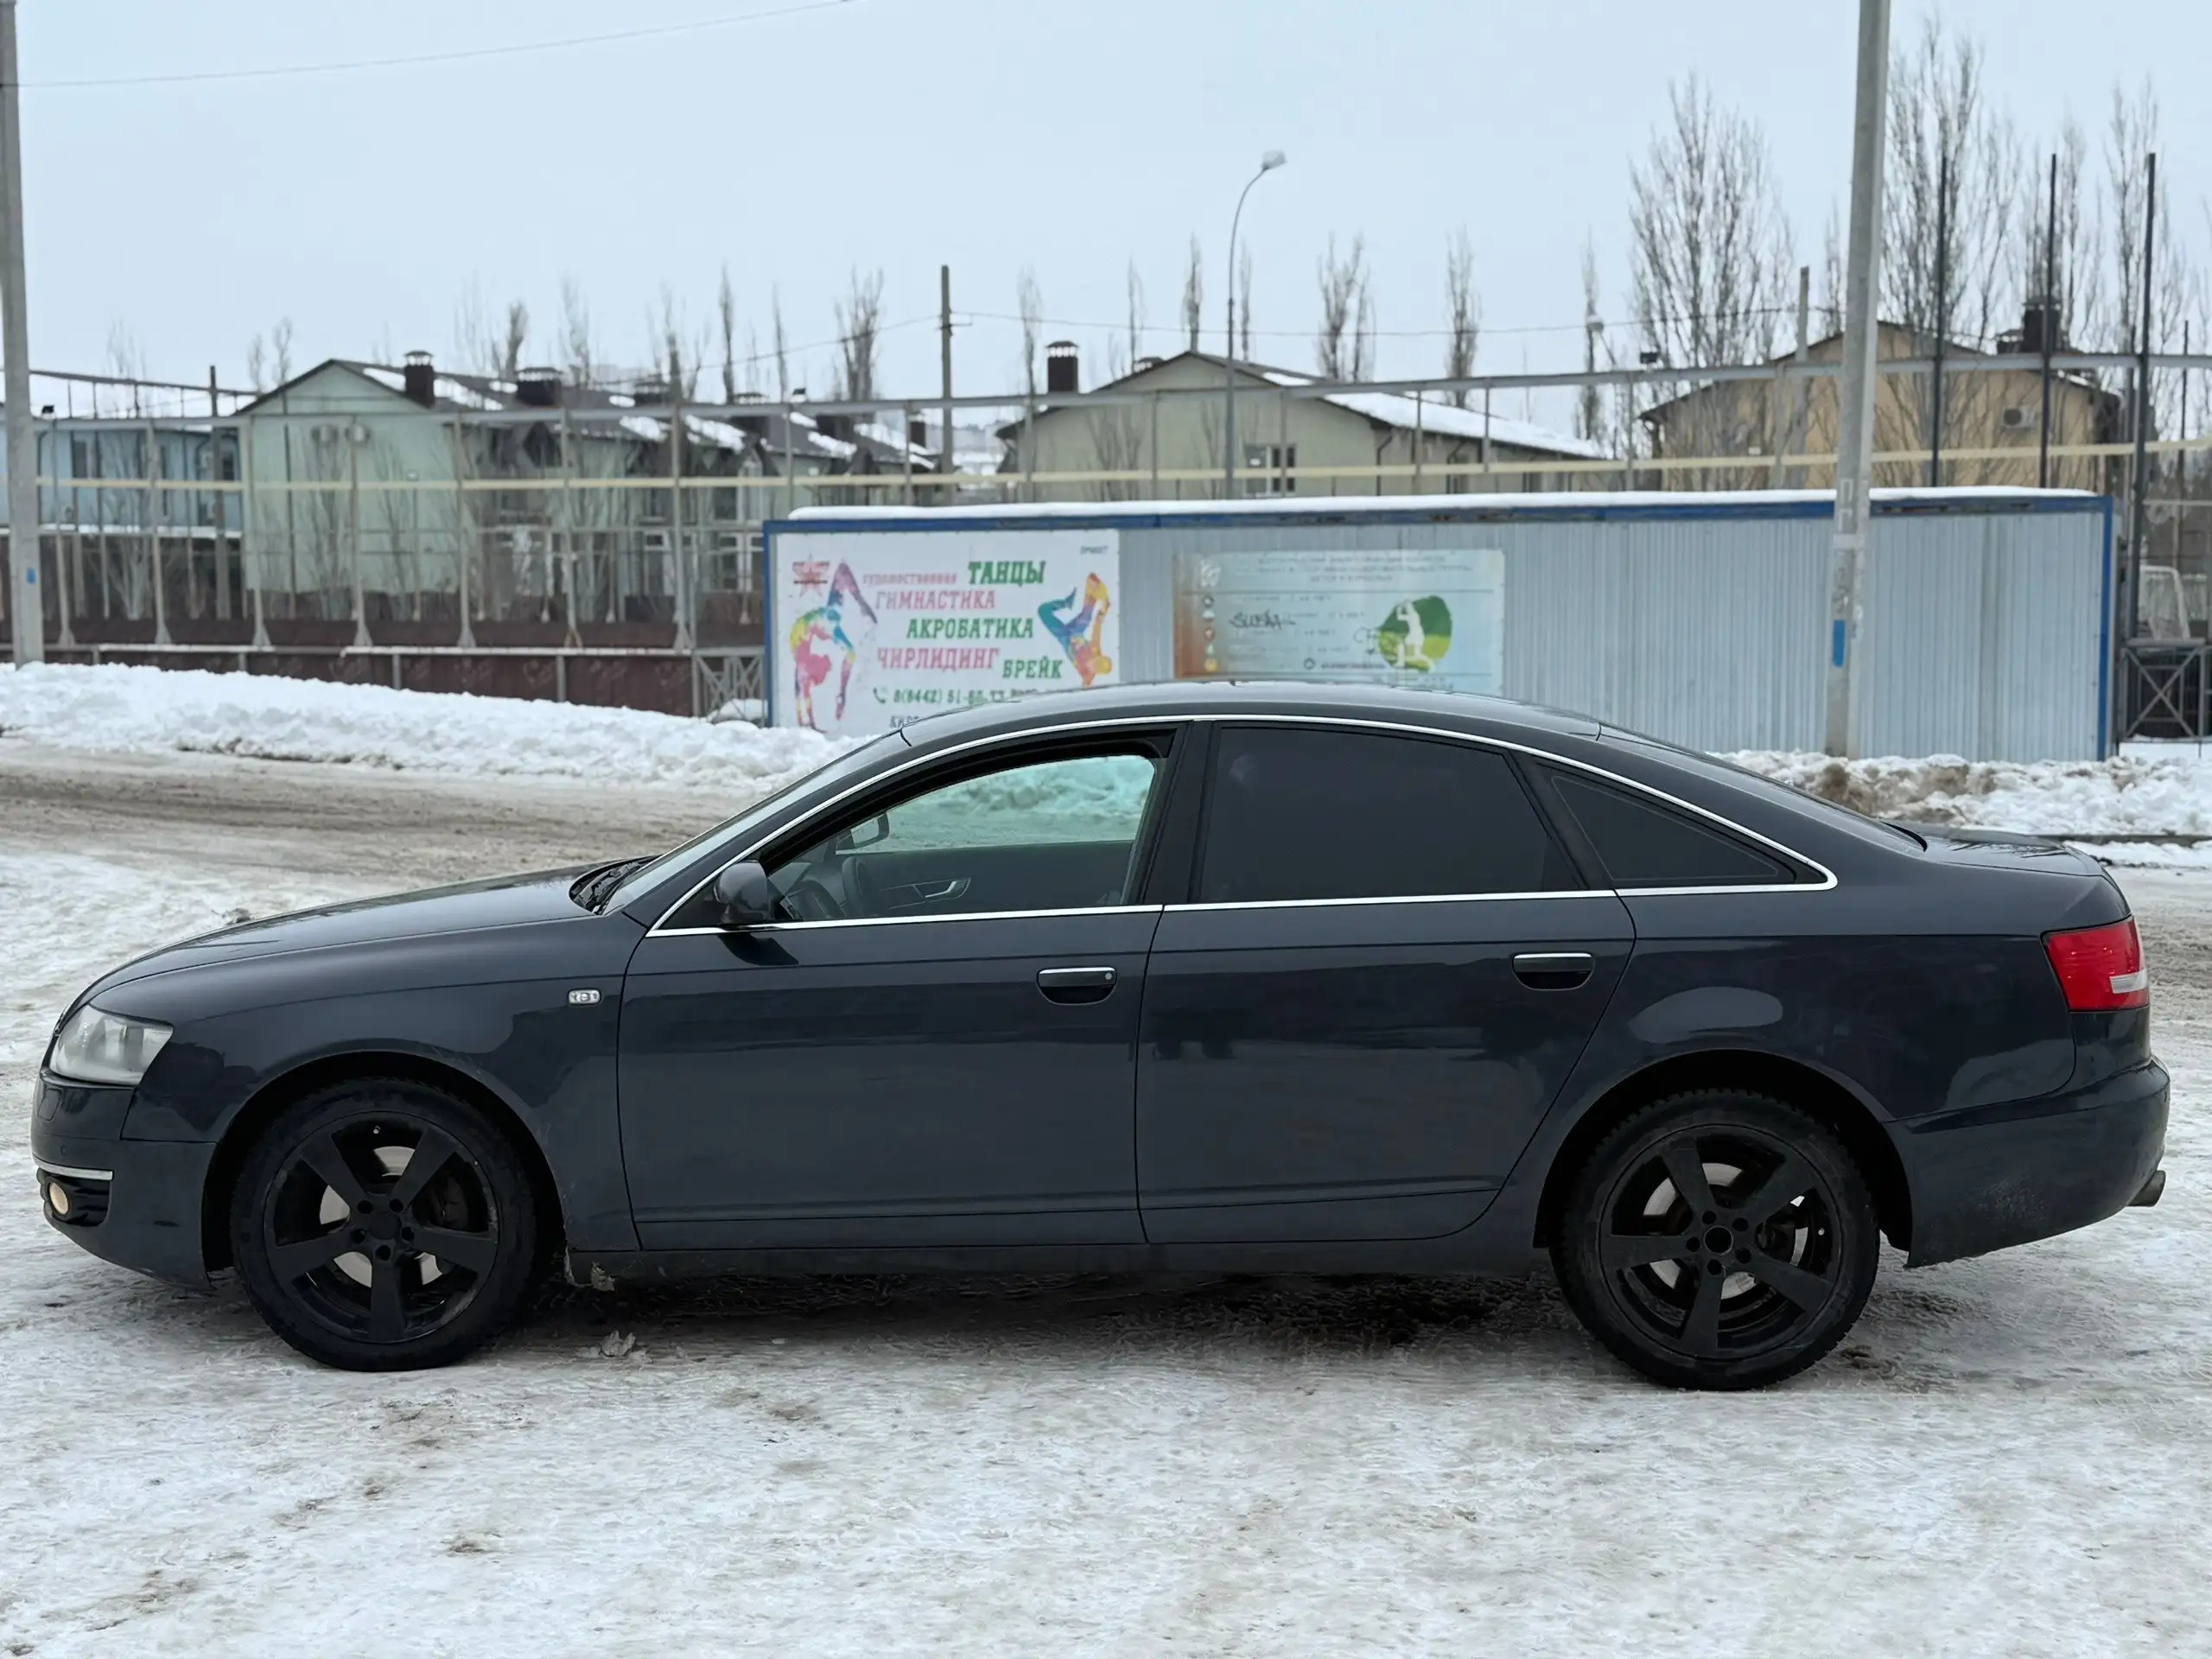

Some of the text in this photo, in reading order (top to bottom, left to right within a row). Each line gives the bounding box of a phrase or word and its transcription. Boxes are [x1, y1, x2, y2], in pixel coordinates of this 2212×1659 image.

[968, 561, 1047, 588] ТАНЦЫ
[875, 590, 995, 610] ГИМНАСТИКА
[906, 618, 1034, 639] АКРОБАТИКА
[878, 647, 1001, 671] ЧИРЛИДИНГ
[1002, 656, 1064, 678] БРЕЙК
